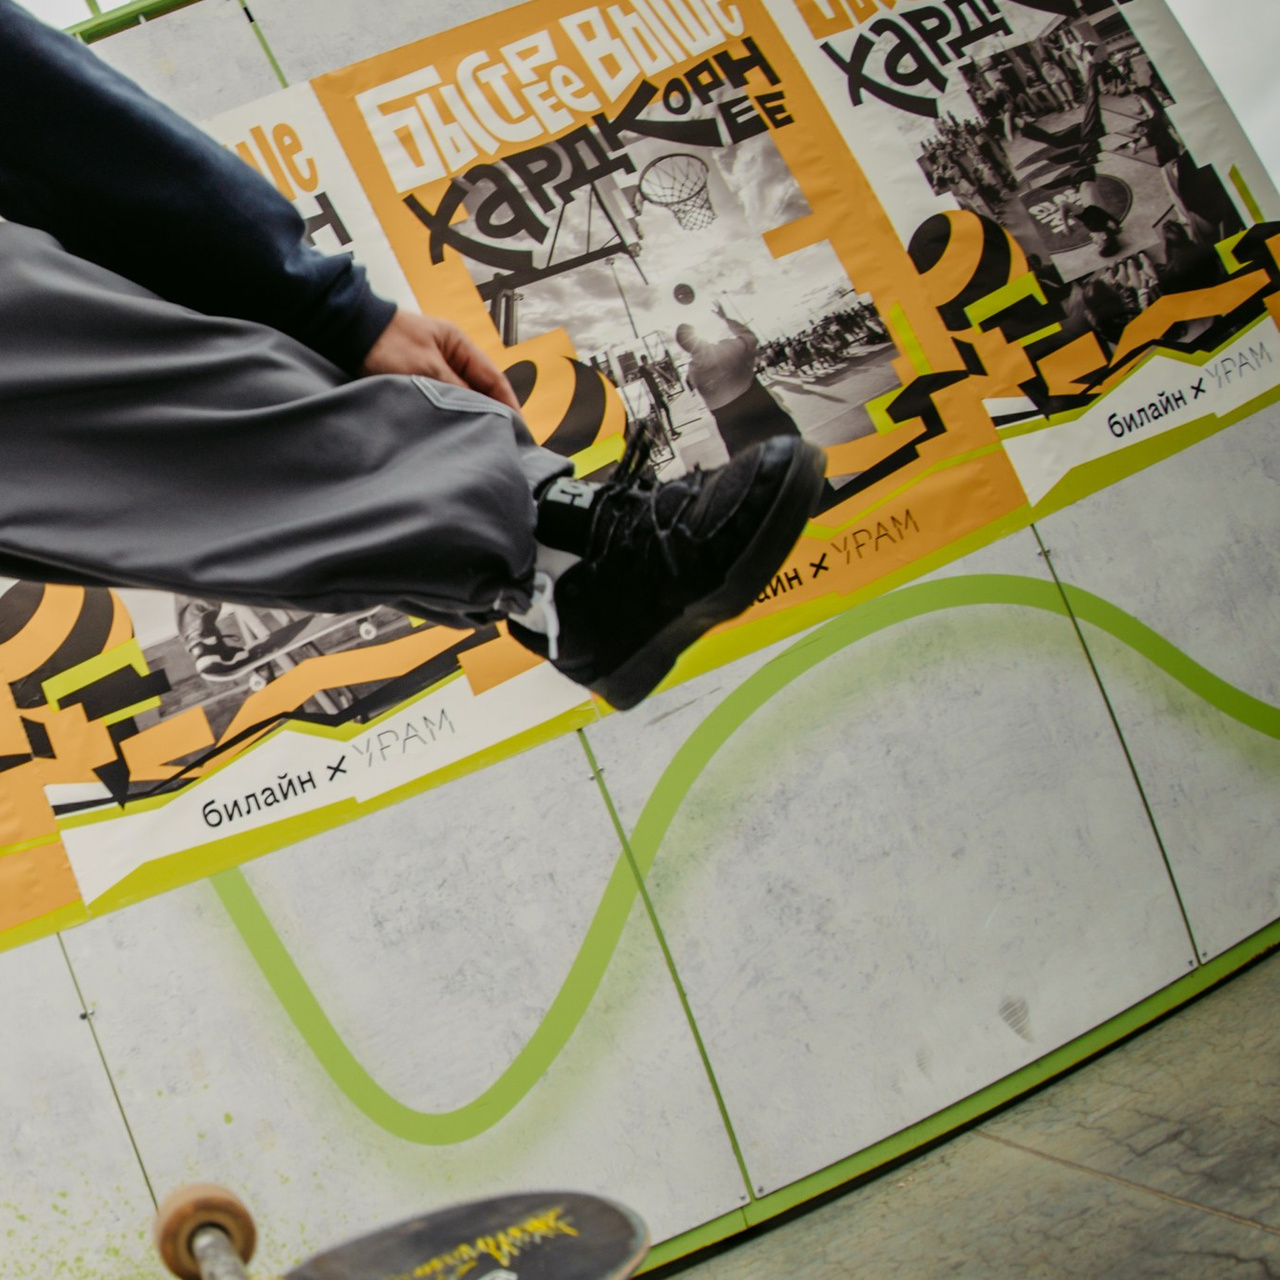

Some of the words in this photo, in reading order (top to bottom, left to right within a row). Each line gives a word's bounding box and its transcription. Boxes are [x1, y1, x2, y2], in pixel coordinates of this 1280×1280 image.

[1108, 390, 1187, 438] билайн
[1205, 341, 1273, 388] УРАМ
[831, 509, 919, 564] УРАМ
[202, 771, 316, 827] билайн
[352, 708, 455, 767] УРАМ
